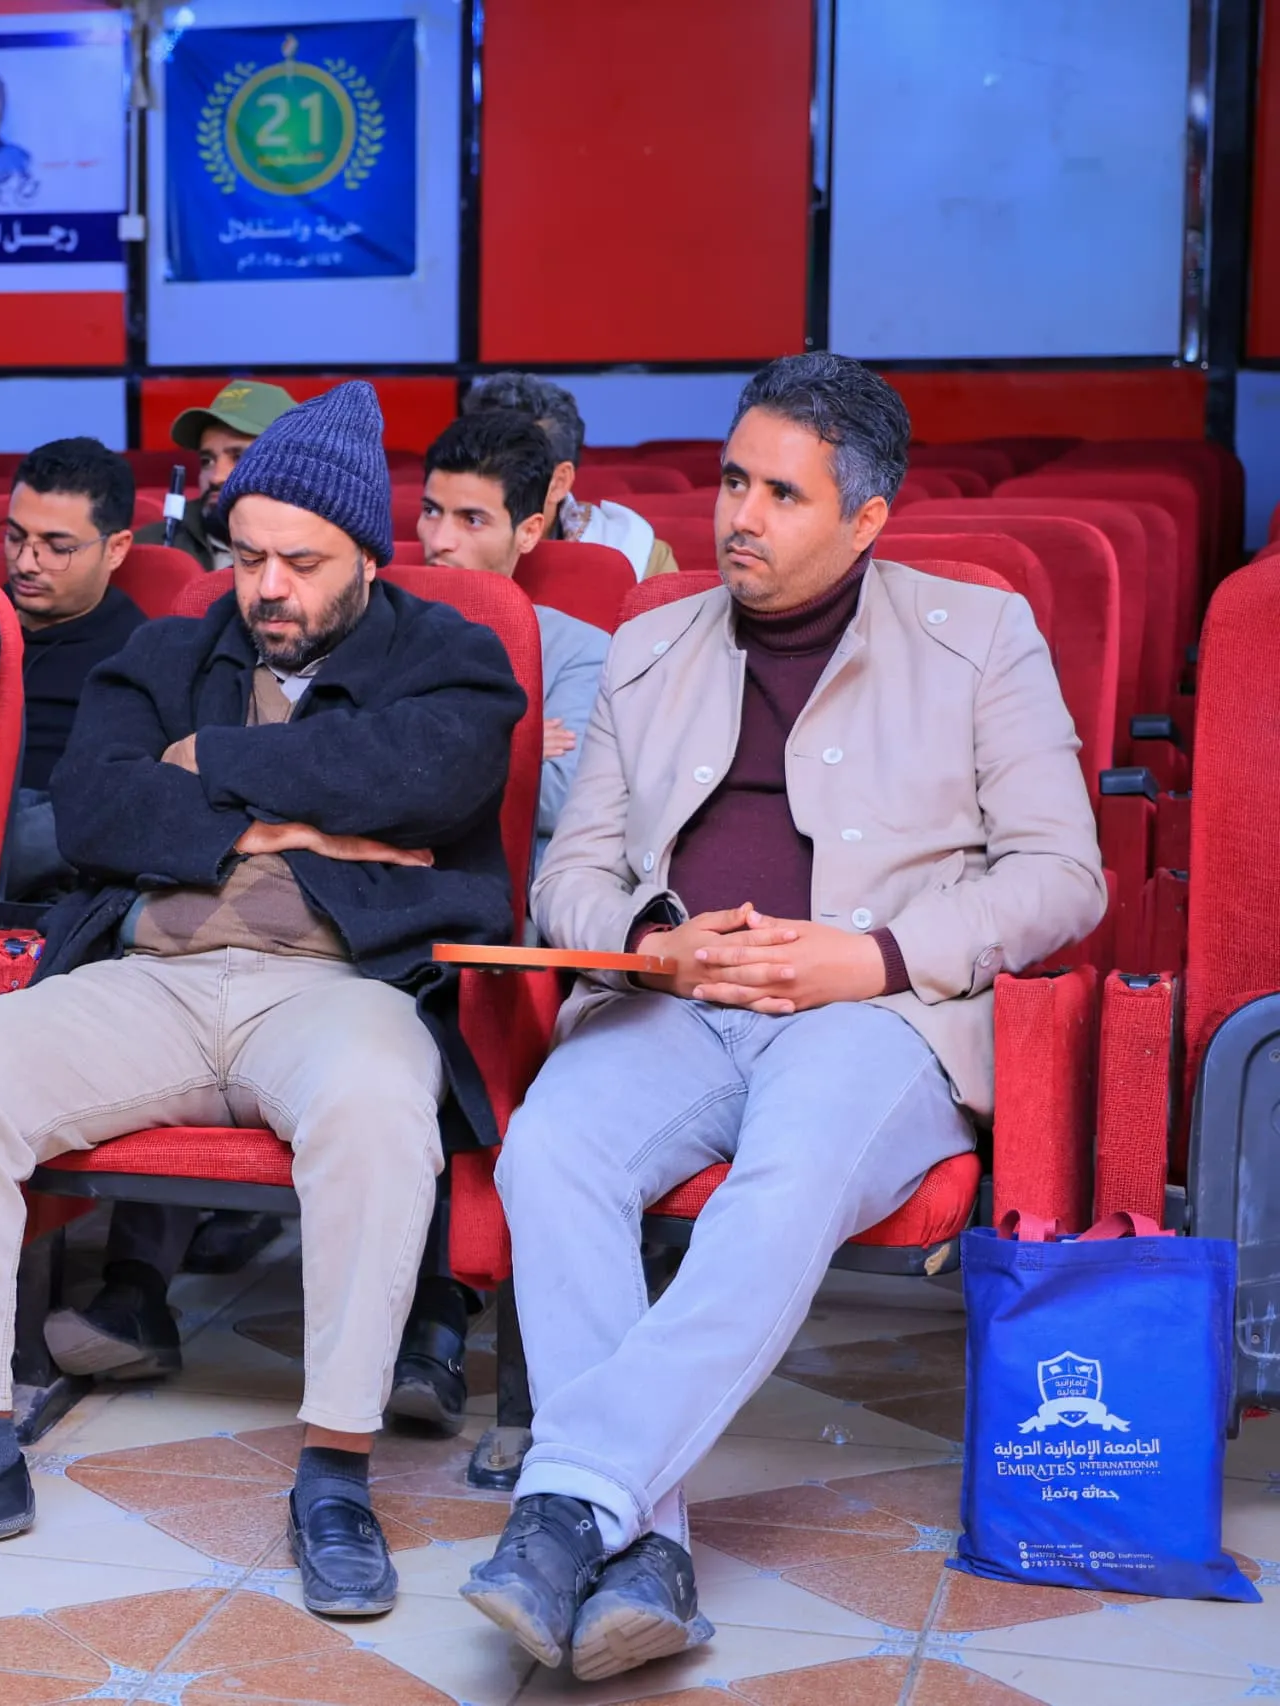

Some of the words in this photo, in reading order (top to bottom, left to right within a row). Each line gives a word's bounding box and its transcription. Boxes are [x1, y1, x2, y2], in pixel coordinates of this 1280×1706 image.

[256, 92, 324, 147] 21
[3, 220, 79, 253] رجل
[219, 218, 311, 243] واستقلال
[315, 216, 362, 241] حرية
[994, 1440, 1041, 1460] الدولية
[1044, 1440, 1100, 1460] الإماراتية
[1104, 1438, 1160, 1457] الجامعة
[997, 1461, 1076, 1480] EMIRATES
[1082, 1484, 1120, 1501] حداثة
